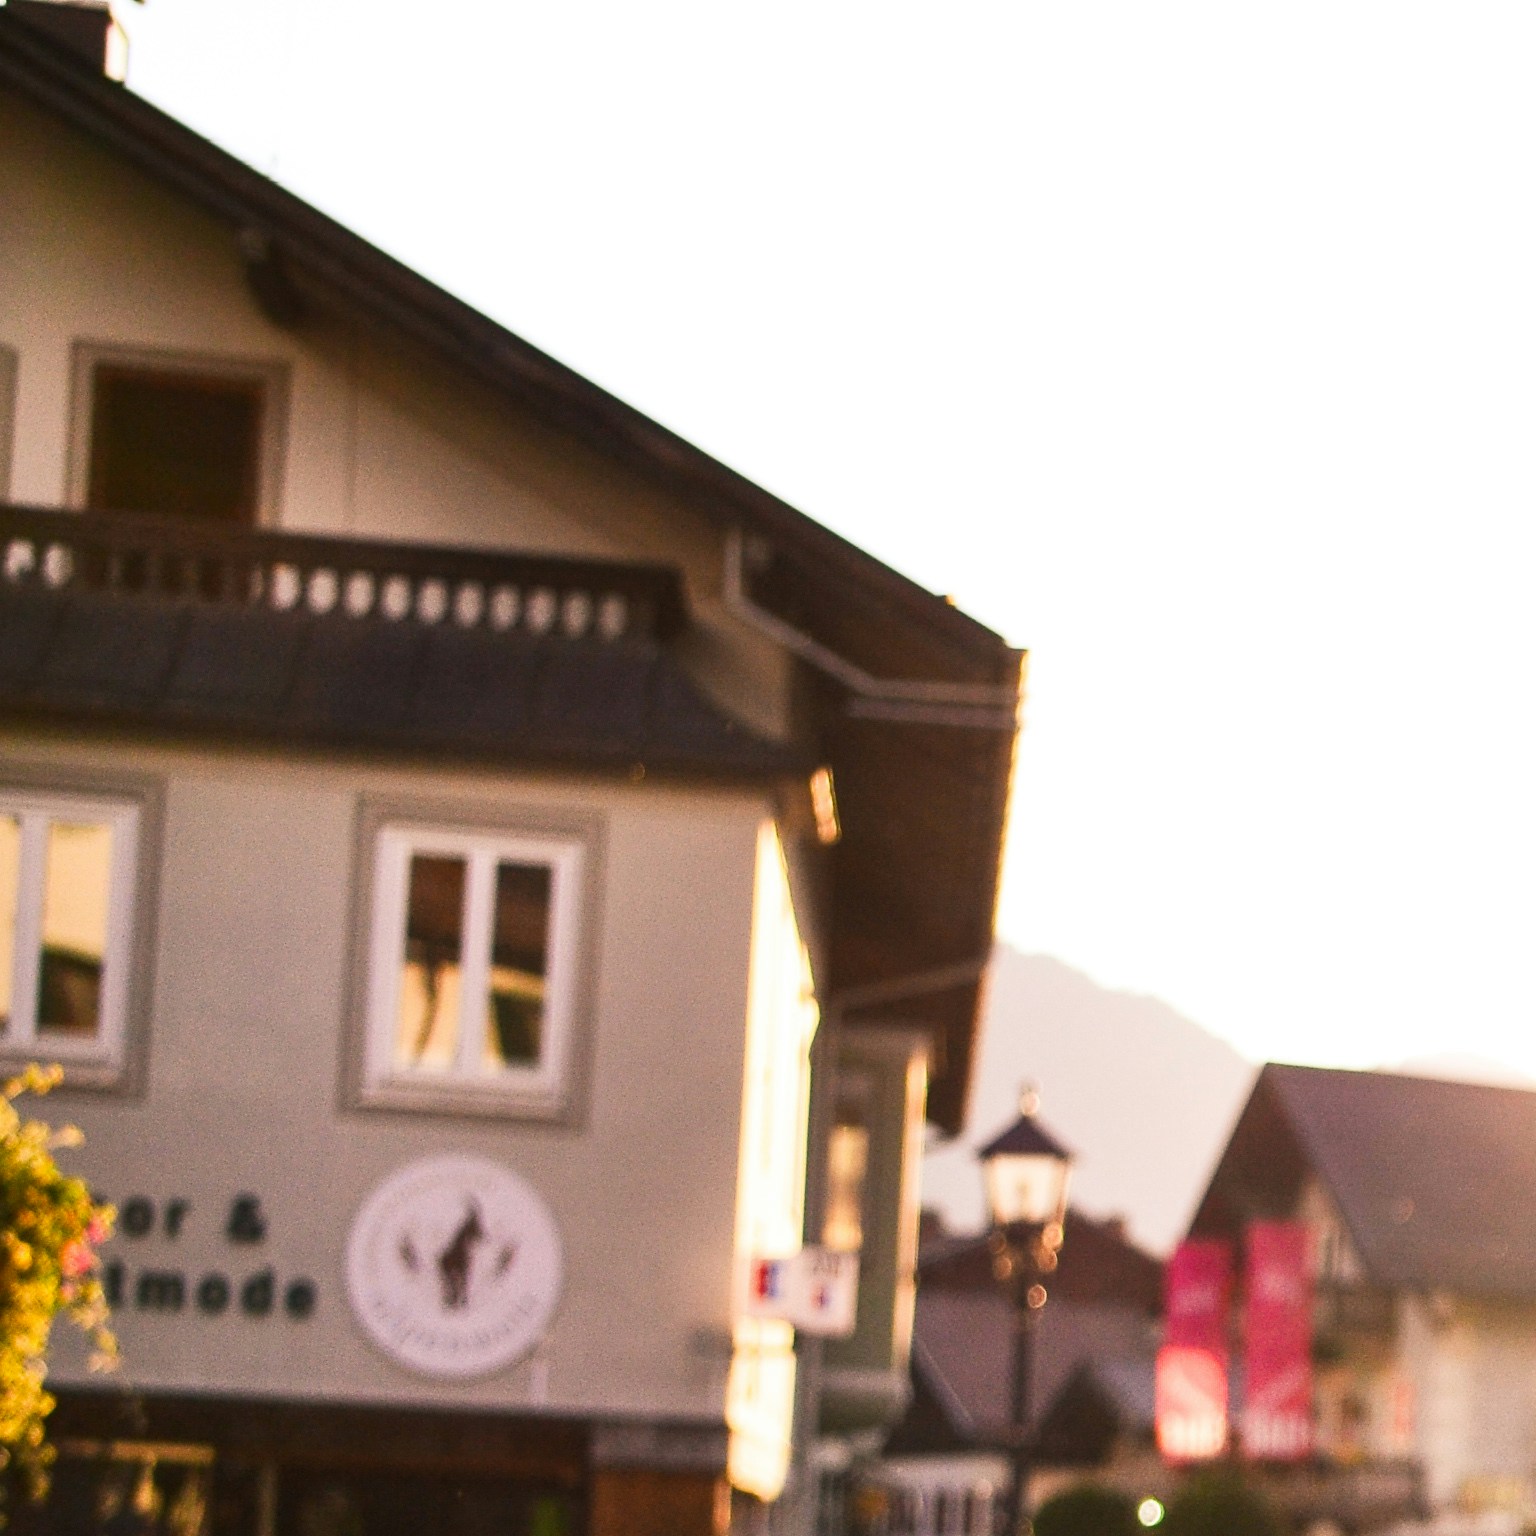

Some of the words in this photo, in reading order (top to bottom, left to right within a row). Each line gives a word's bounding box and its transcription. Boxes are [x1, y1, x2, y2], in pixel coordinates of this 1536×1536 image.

[94, 1194, 190, 1240] or
[226, 1191, 268, 1245] &
[82, 1258, 318, 1322] tmode
